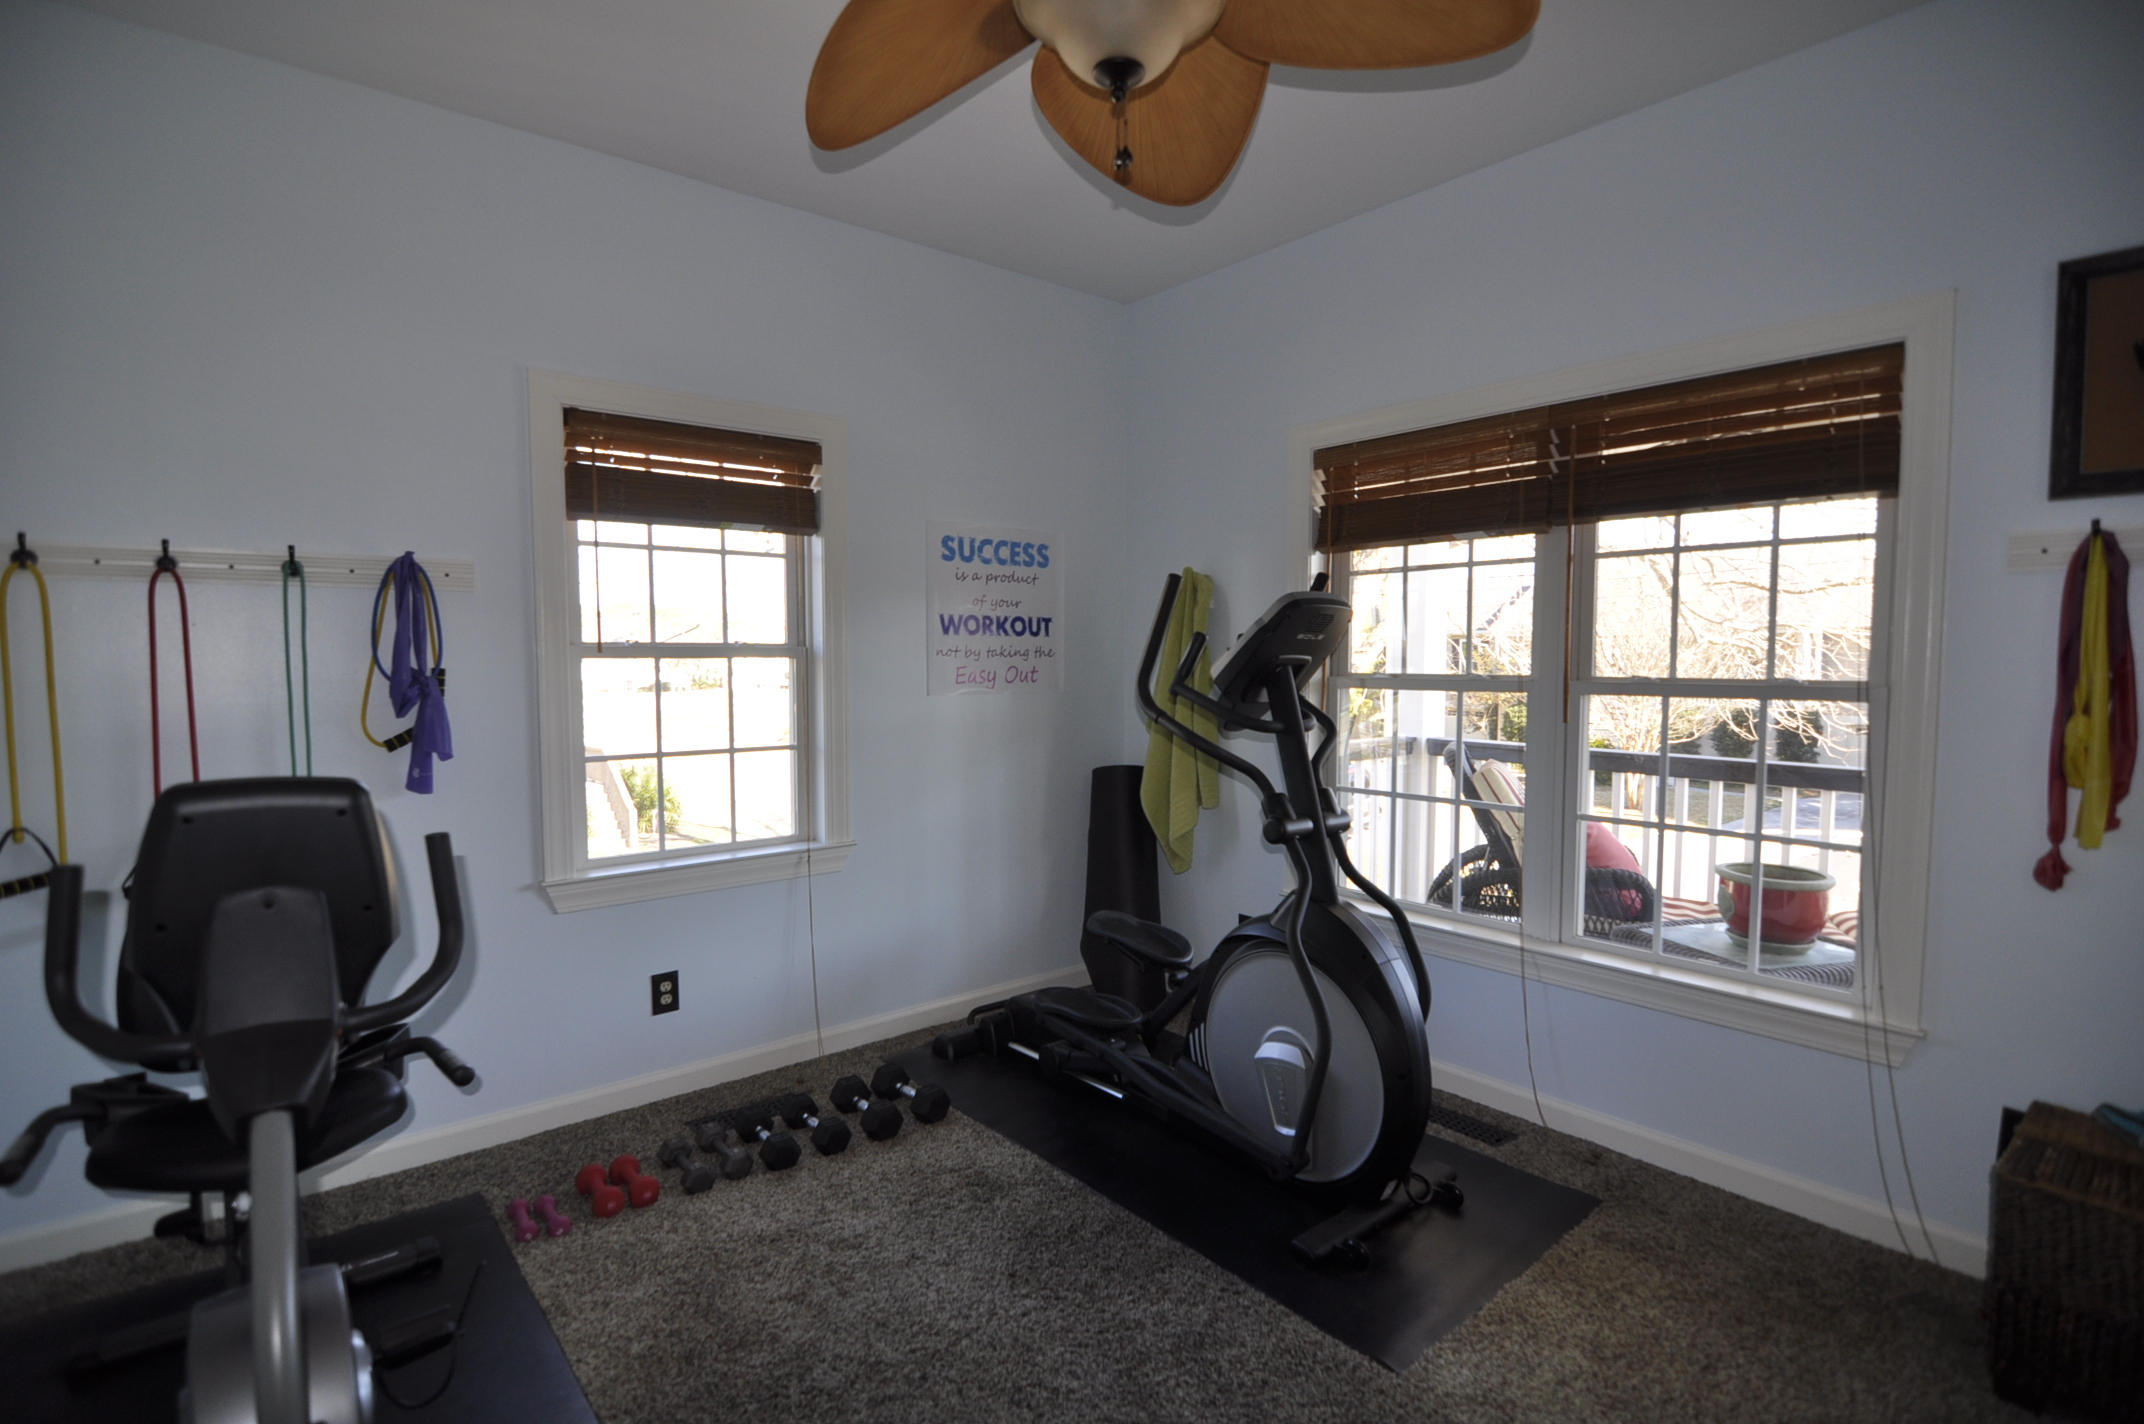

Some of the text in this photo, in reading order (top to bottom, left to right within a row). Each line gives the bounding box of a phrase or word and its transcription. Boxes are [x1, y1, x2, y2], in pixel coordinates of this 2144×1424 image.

[941, 535, 1050, 568] SUCCESS
[955, 567, 1040, 586] is a product
[972, 594, 1022, 611] of your
[939, 613, 1053, 637] WORKOUT
[935, 644, 1056, 662] not by taking the
[955, 665, 1040, 690] Easy Out
